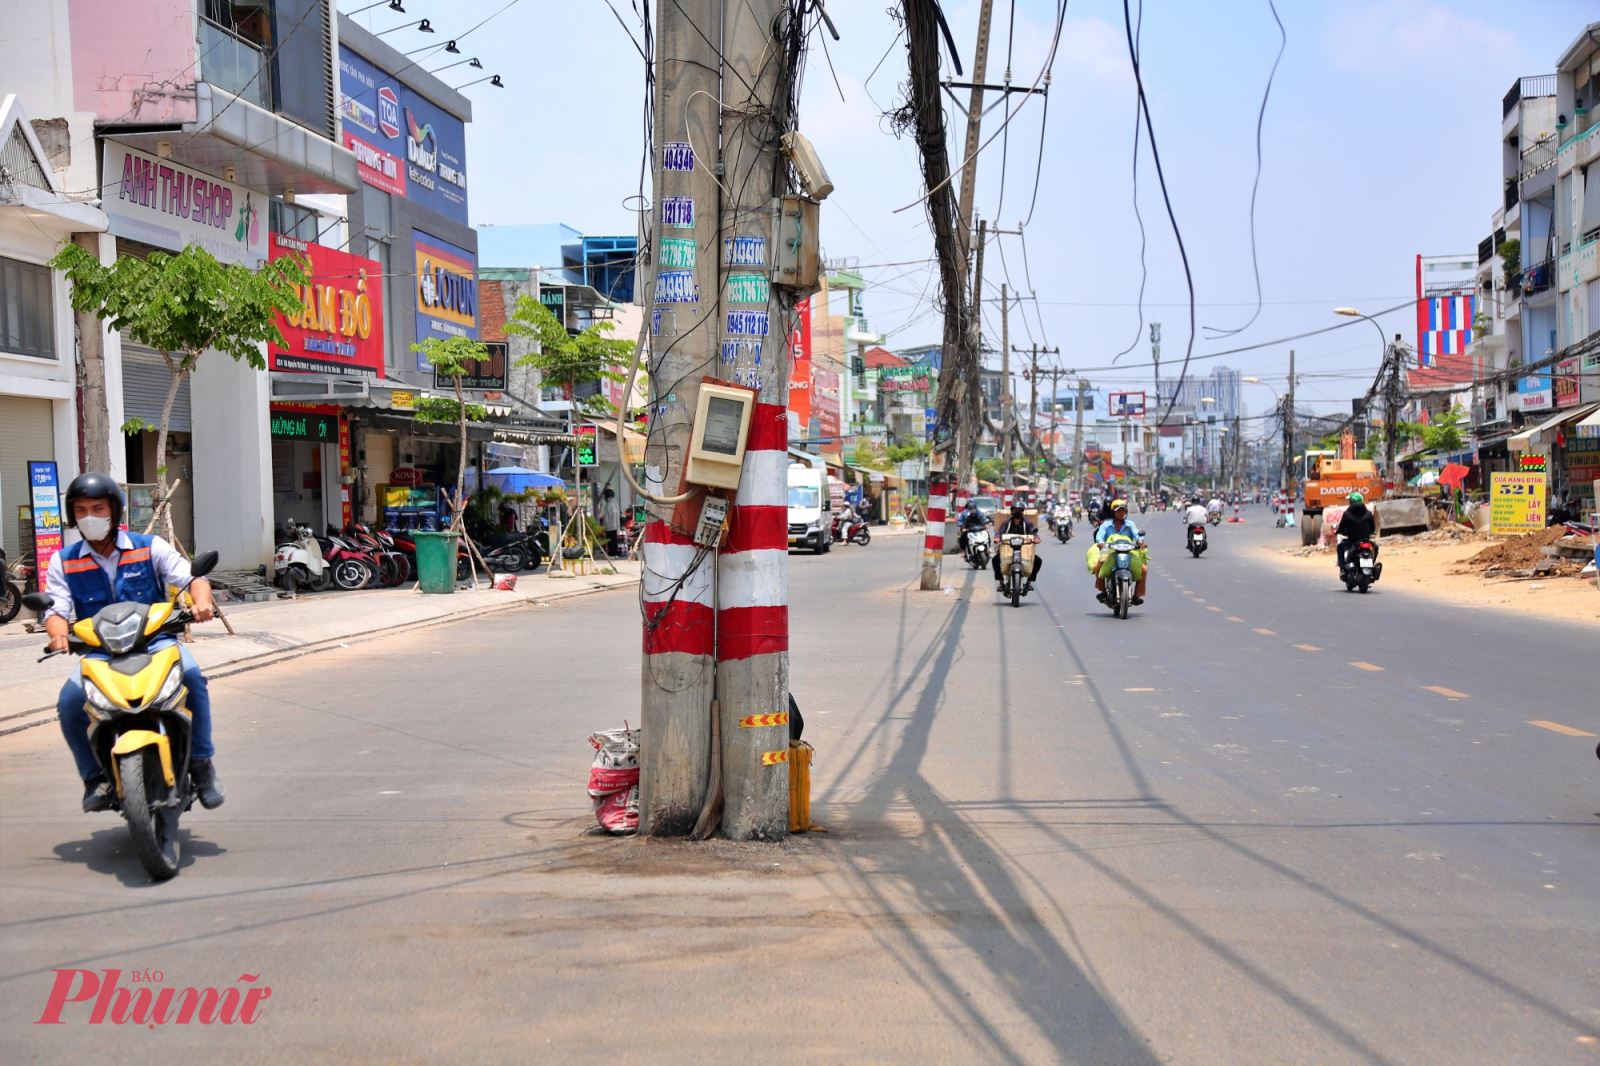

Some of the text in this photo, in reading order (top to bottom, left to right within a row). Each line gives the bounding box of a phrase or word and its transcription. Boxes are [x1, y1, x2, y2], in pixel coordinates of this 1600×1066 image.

[381, 101, 399, 127] TOA
[351, 139, 382, 173] TRUNG
[407, 134, 437, 173] Dulux
[119, 152, 158, 209] ANH
[191, 178, 233, 230] SHOP
[433, 264, 474, 316] JOTUN
[541, 290, 563, 305] BÁNH
[339, 267, 372, 340] ĐỒ
[271, 416, 295, 435] MỪNG
[1499, 484, 1534, 495] 521
[1508, 475, 1525, 483] HÀNG
[1528, 497, 1541, 508] LẤY
